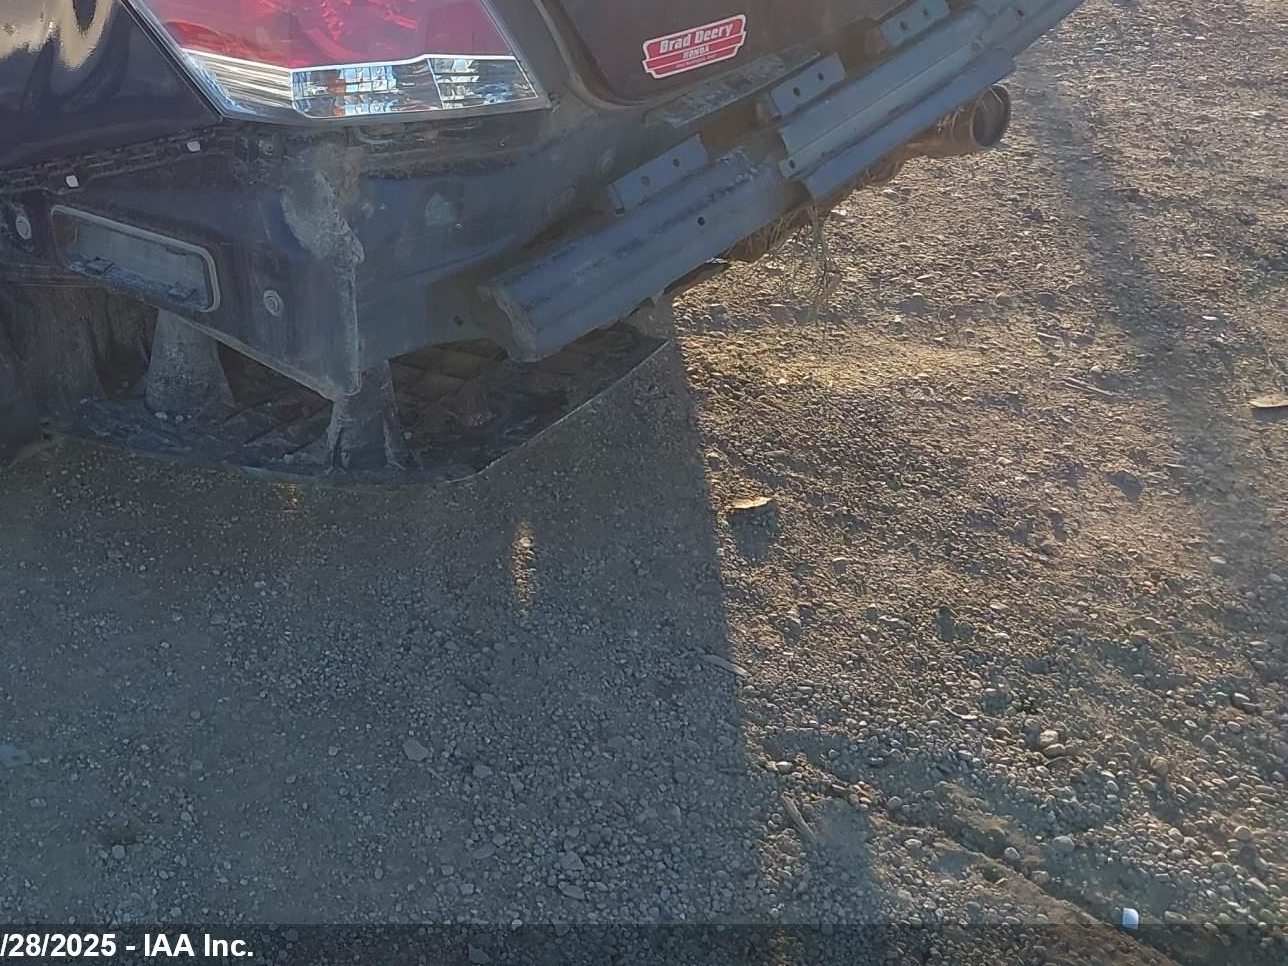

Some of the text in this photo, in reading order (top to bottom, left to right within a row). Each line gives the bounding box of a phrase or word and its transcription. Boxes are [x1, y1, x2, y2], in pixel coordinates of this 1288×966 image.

[660, 23, 733, 53] Brad Deery
[683, 46, 709, 59] HONDA
